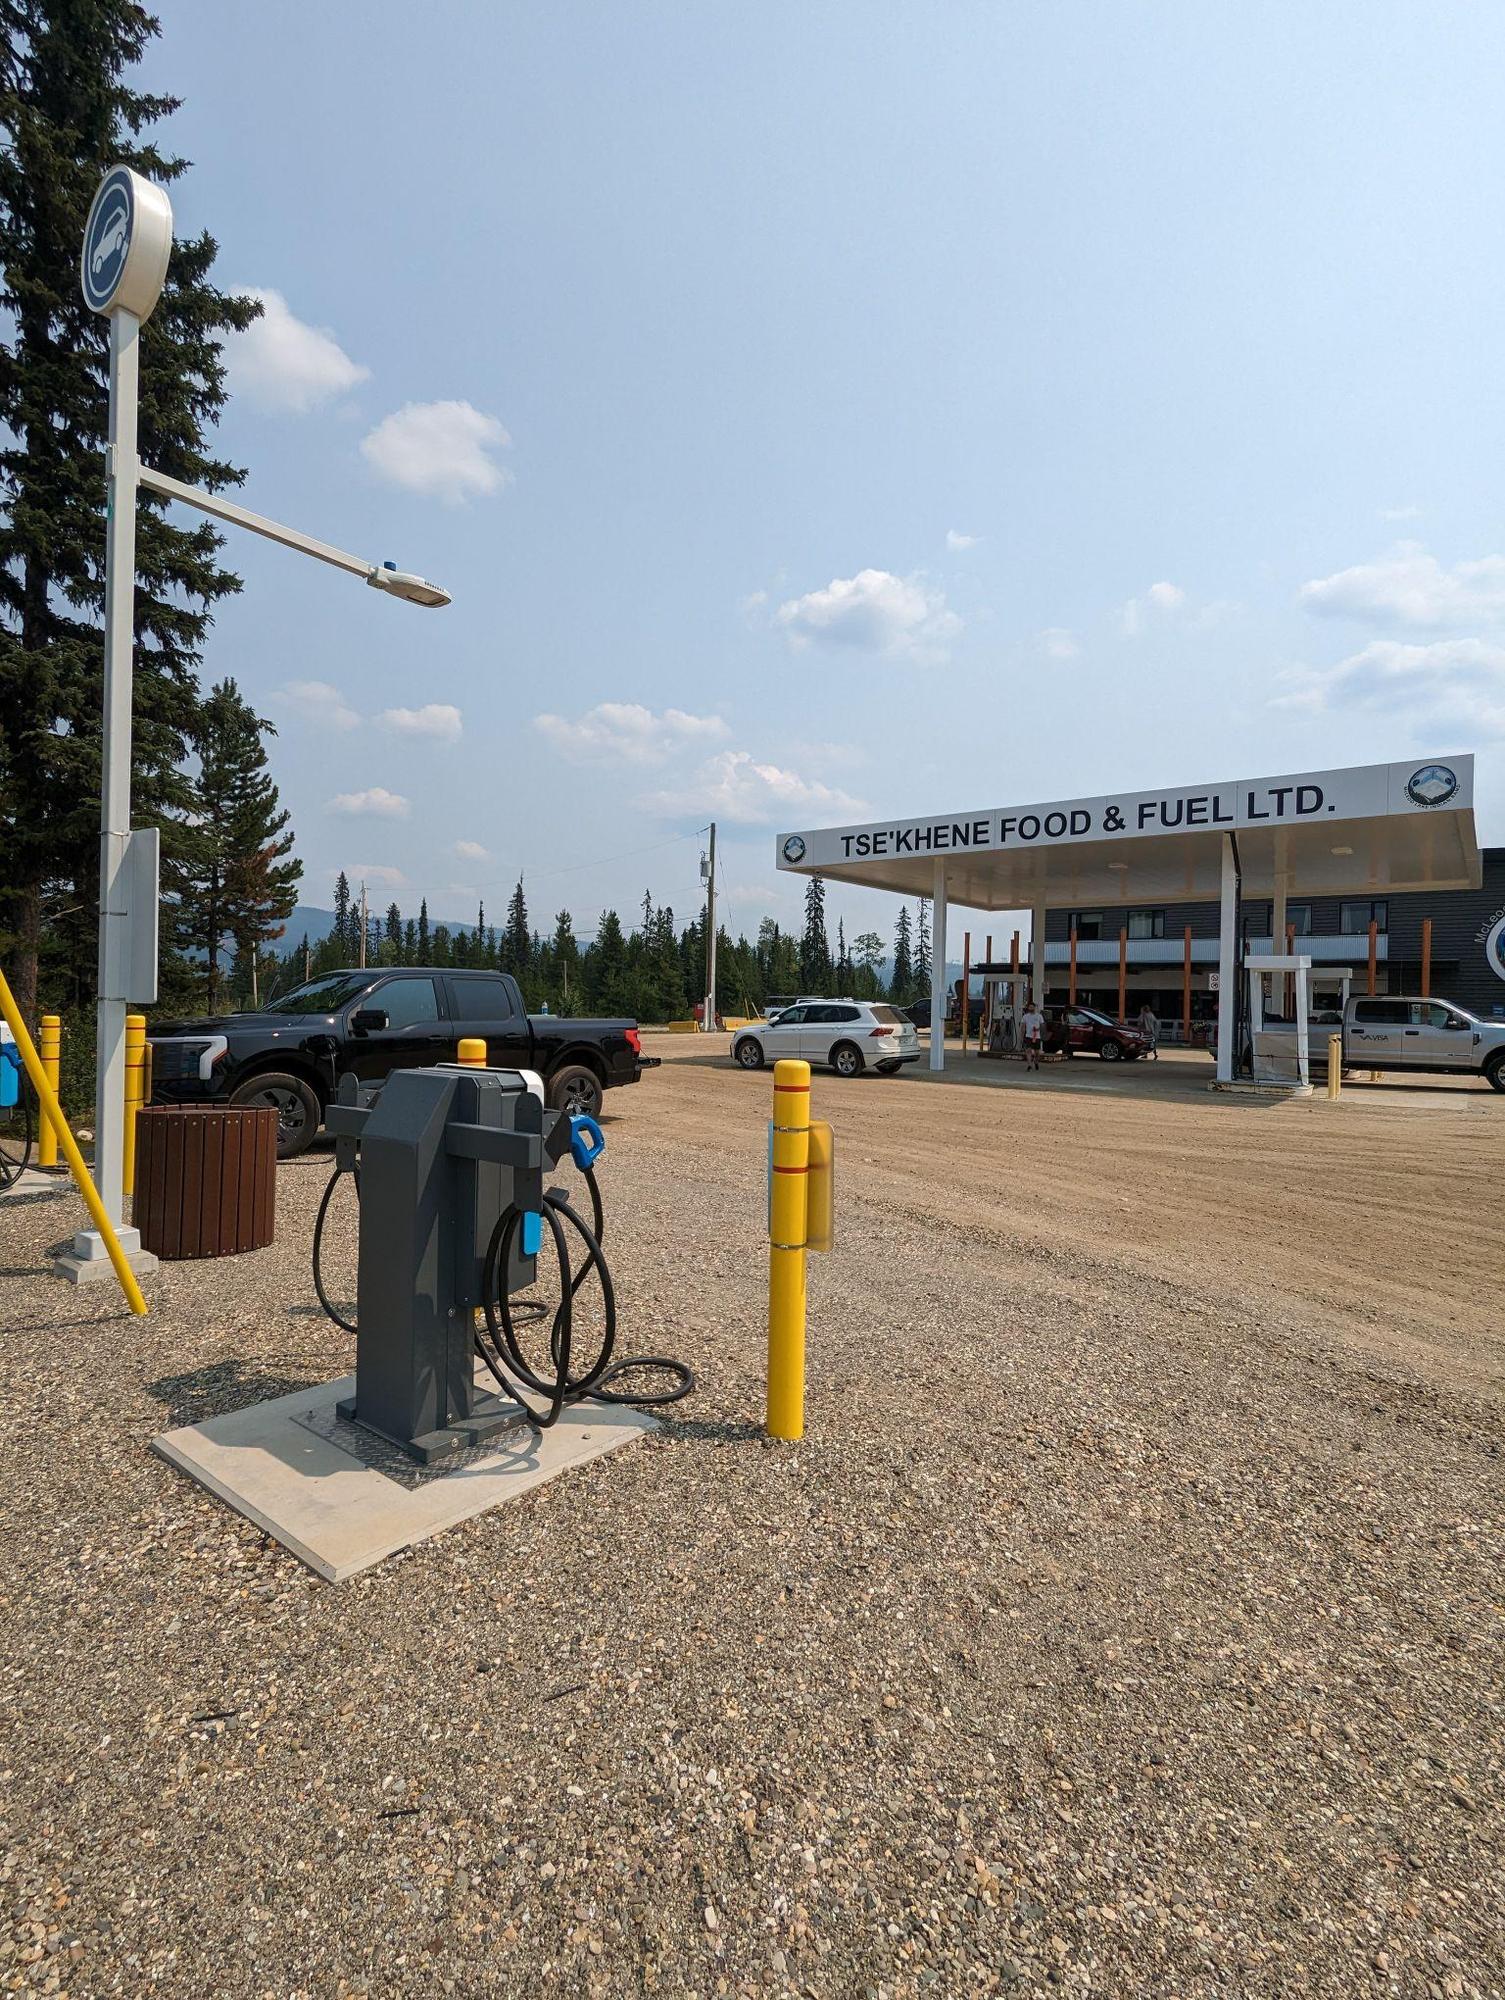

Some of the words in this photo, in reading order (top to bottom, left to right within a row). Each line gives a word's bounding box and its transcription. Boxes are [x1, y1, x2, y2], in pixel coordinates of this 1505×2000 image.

[840, 820, 991, 858] TSE'KHENE
[1000, 809, 1093, 843] FOOD
[1102, 805, 1127, 833] &
[1138, 795, 1234, 829] FUEL
[1247, 784, 1336, 820] LTD.
[1474, 902, 1505, 943] McLeo
